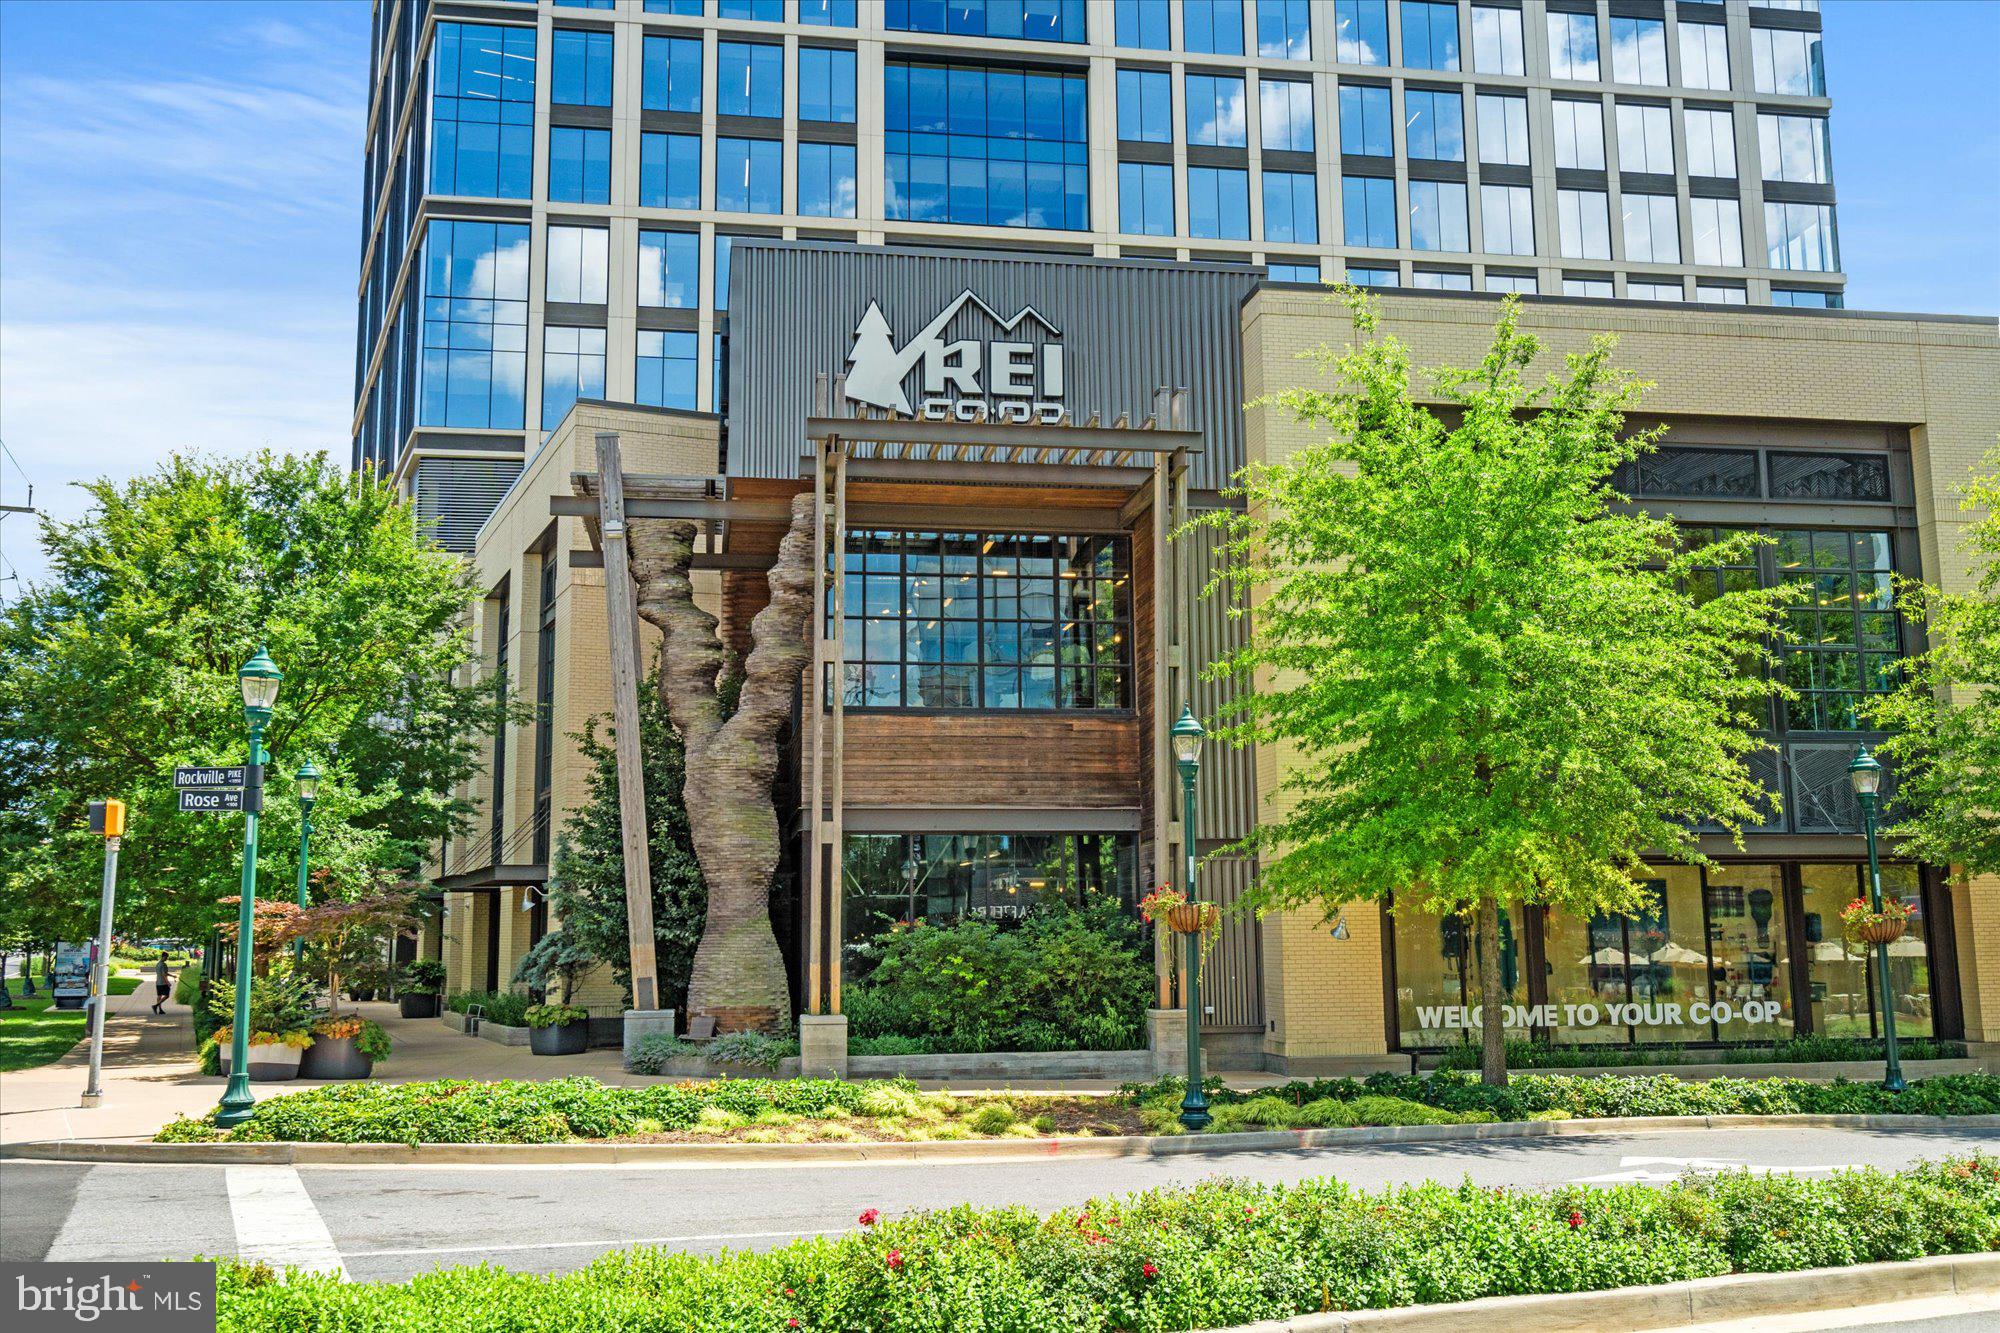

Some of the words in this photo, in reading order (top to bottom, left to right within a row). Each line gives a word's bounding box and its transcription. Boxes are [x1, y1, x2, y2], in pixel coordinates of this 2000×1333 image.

[924, 338, 1063, 397] REI
[178, 770, 225, 785] Rockville
[227, 769, 242, 778] PIKE
[184, 793, 220, 807] Rose
[224, 793, 239, 802] Ave
[1564, 1003, 1599, 1027] TO
[1605, 1002, 1684, 1026] YOUR
[1689, 1000, 1781, 1025] CO-OP
